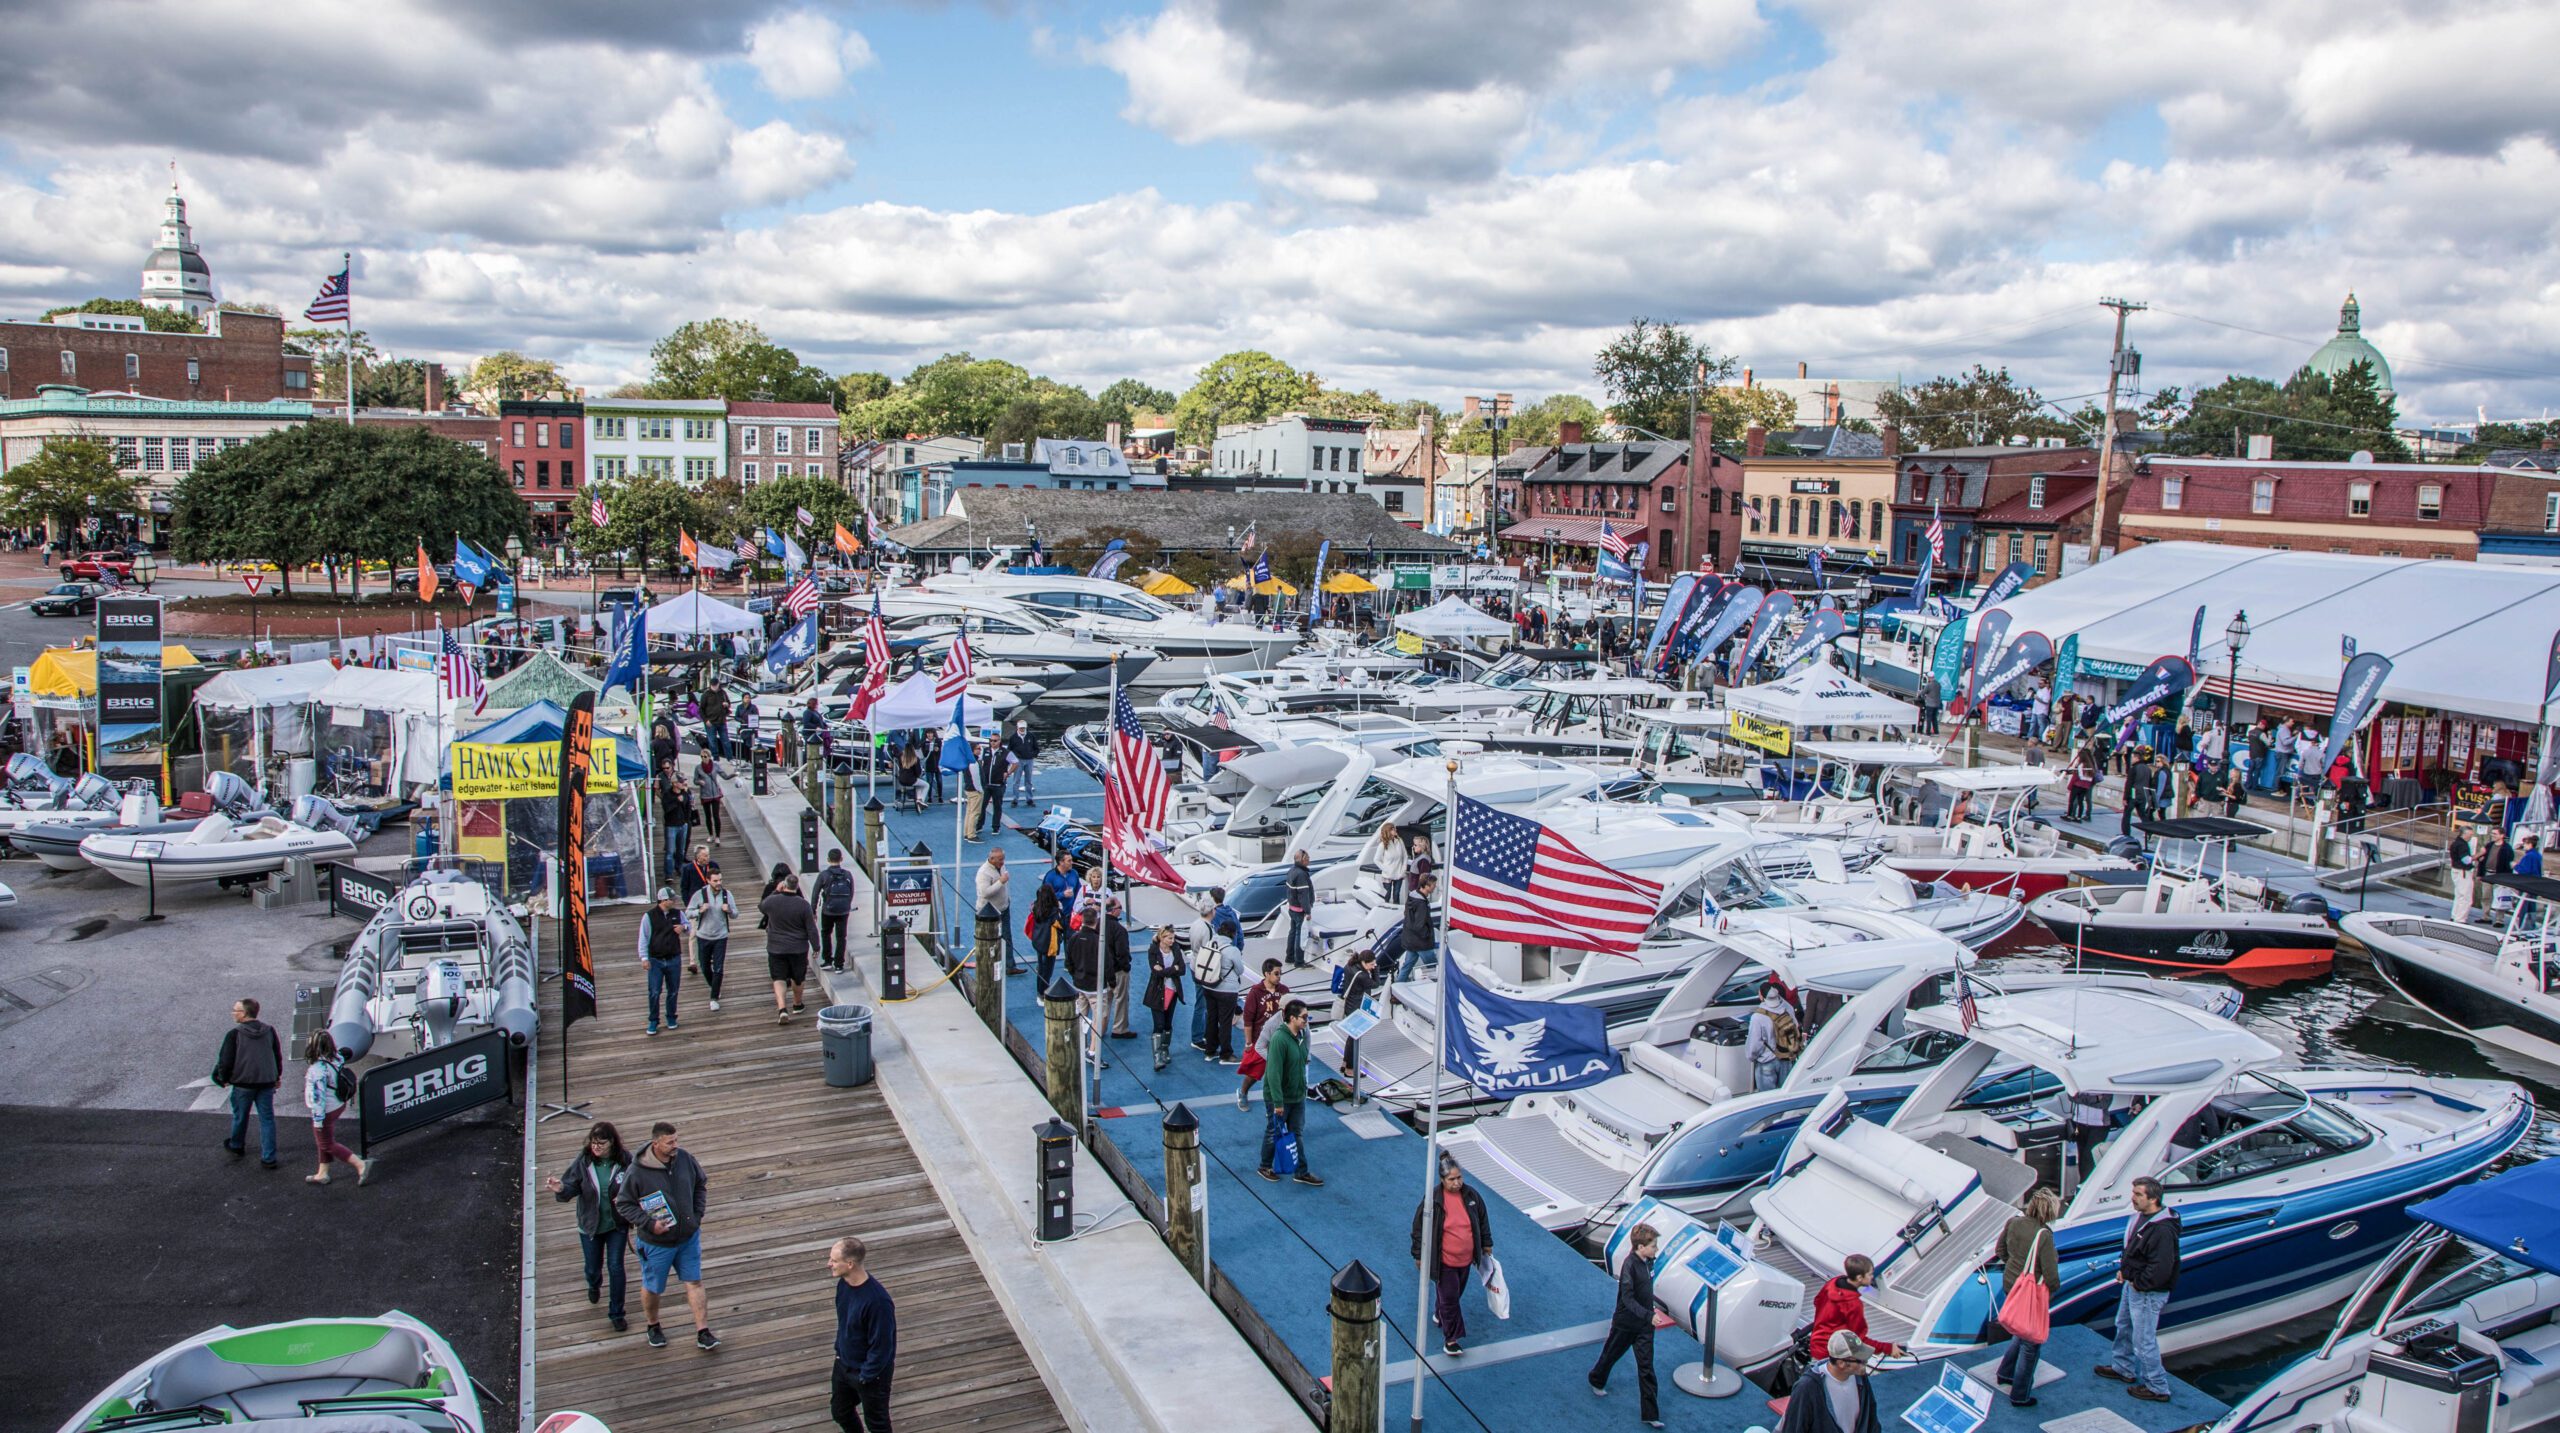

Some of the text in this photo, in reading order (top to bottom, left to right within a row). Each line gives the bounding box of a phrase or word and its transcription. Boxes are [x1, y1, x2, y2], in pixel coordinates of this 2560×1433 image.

[1490, 575, 1518, 583] YACHTS
[106, 615, 153, 623] BRIG
[1680, 593, 1713, 635] Wellcraft
[1748, 612, 1783, 658] Wellcraft
[1781, 632, 1826, 668] Wellcraft
[1937, 629, 1961, 670] BOAT LOANS
[1977, 631, 2003, 677] Wellcraft
[1816, 689, 1872, 699] Wellcraft
[1978, 658, 2031, 699] Wellcraft
[2347, 664, 2382, 712] Wellcraft
[107, 698, 154, 706] BRIG
[2105, 683, 2169, 724] Wellcraft
[1748, 718, 1784, 739] Wellcraft
[459, 746, 531, 780] HAWK'S
[458, 782, 502, 796] edgewater
[510, 780, 528, 792] kent
[531, 778, 557, 790] island
[341, 877, 388, 907] BRIG
[898, 909, 919, 917] DOCK
[384, 1053, 488, 1108] BRIG
[1586, 1112, 1630, 1142] FORMULA
[1758, 1299, 1798, 1310] MERCURY
